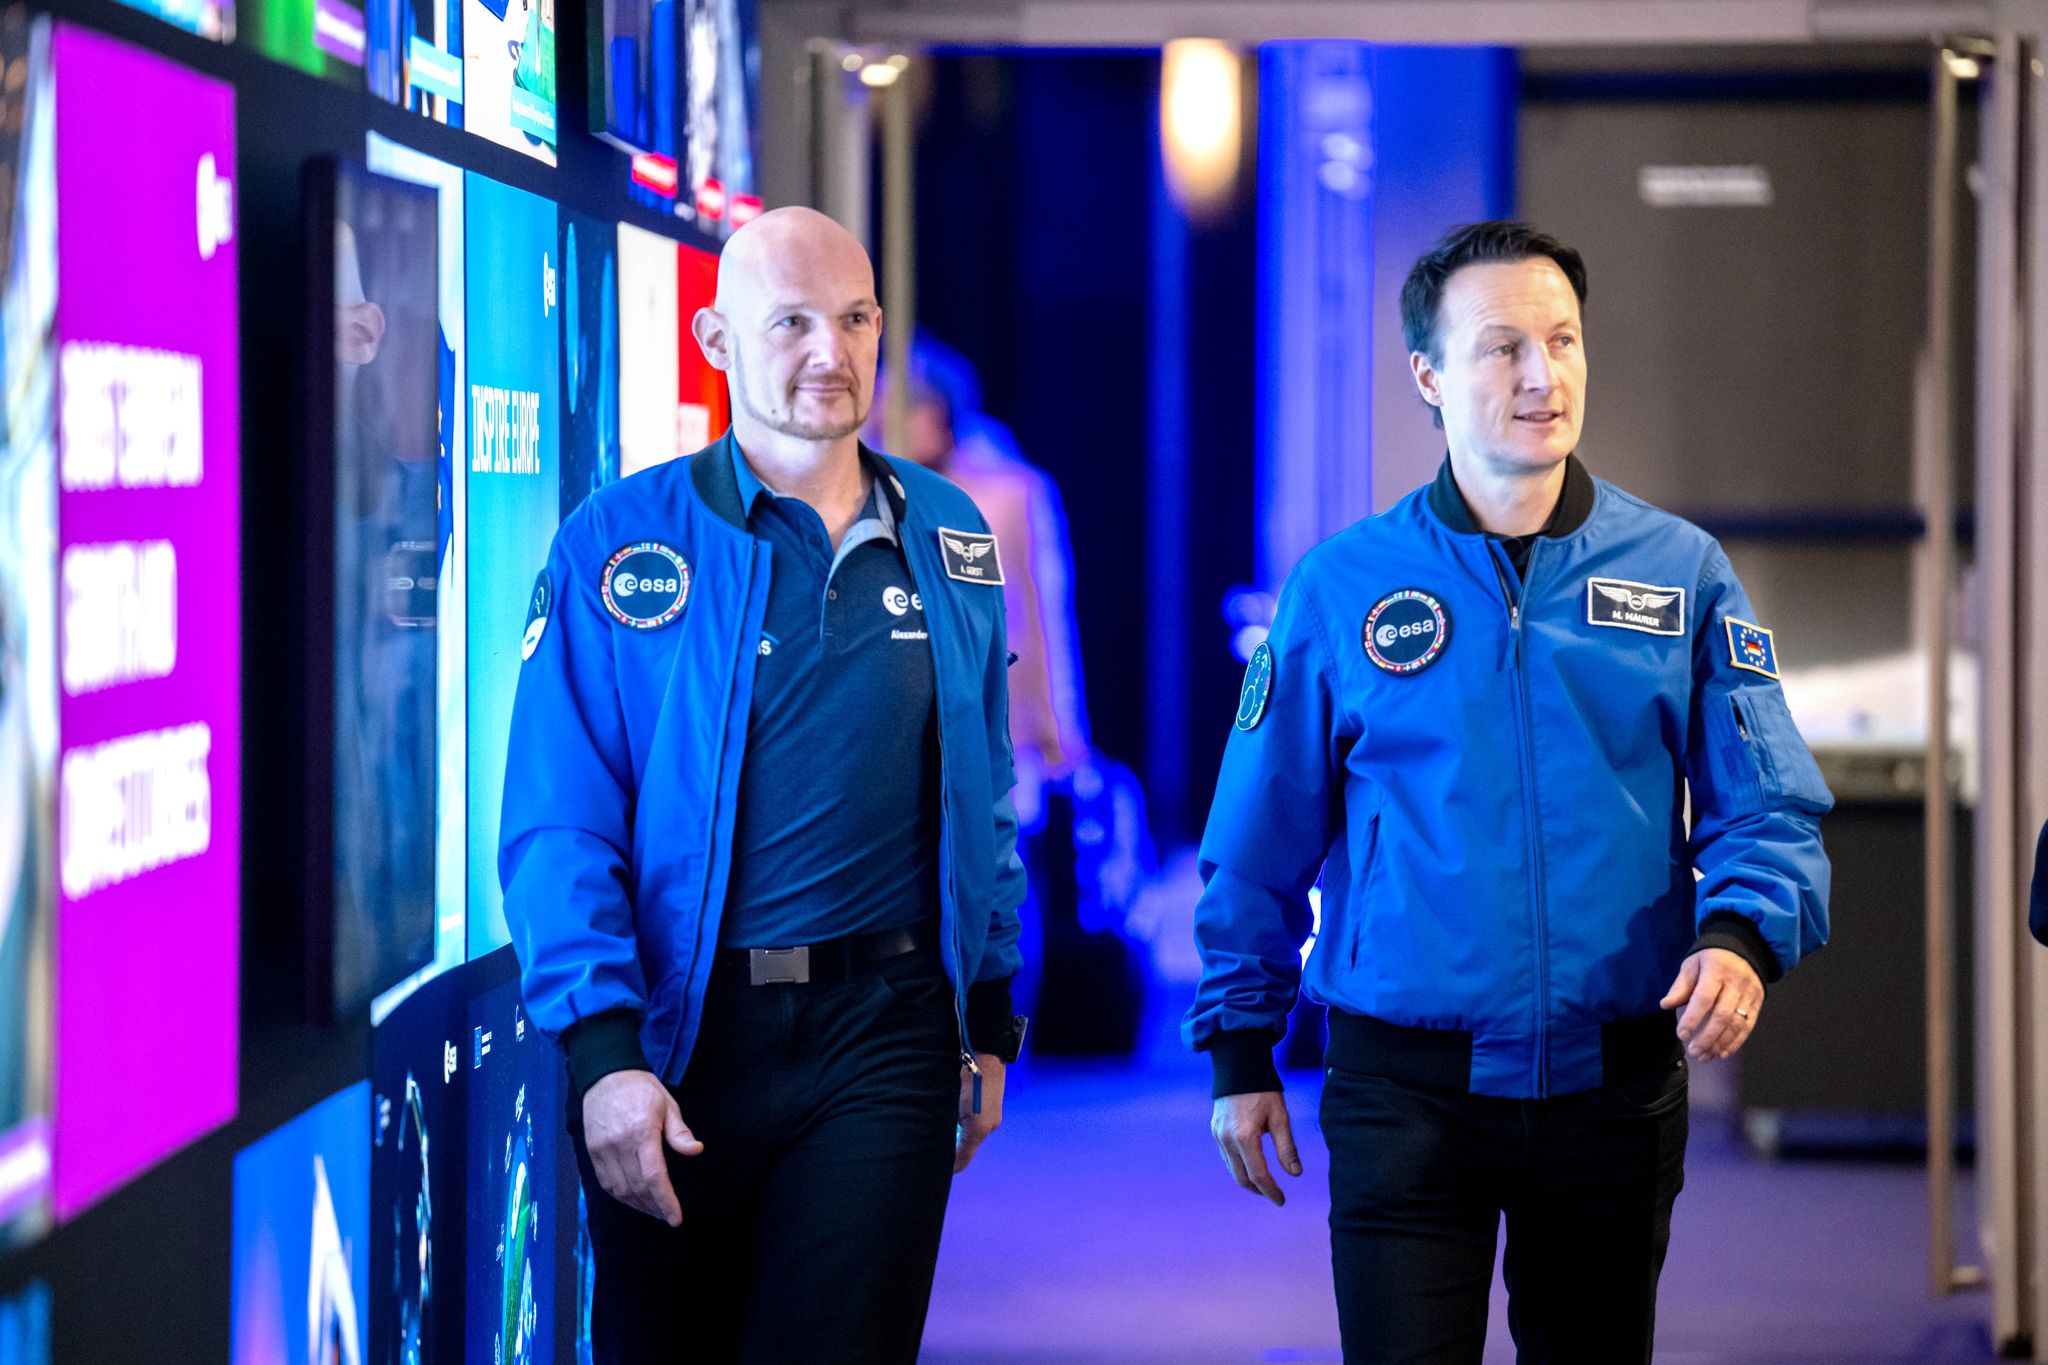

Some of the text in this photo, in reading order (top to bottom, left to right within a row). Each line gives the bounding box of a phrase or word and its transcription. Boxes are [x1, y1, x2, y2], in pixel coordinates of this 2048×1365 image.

[472, 384, 540, 475] INSPIRE EUROPE
[639, 577, 677, 593] esa
[1612, 610, 1660, 627] M. MAURER
[1398, 619, 1435, 638] esa
